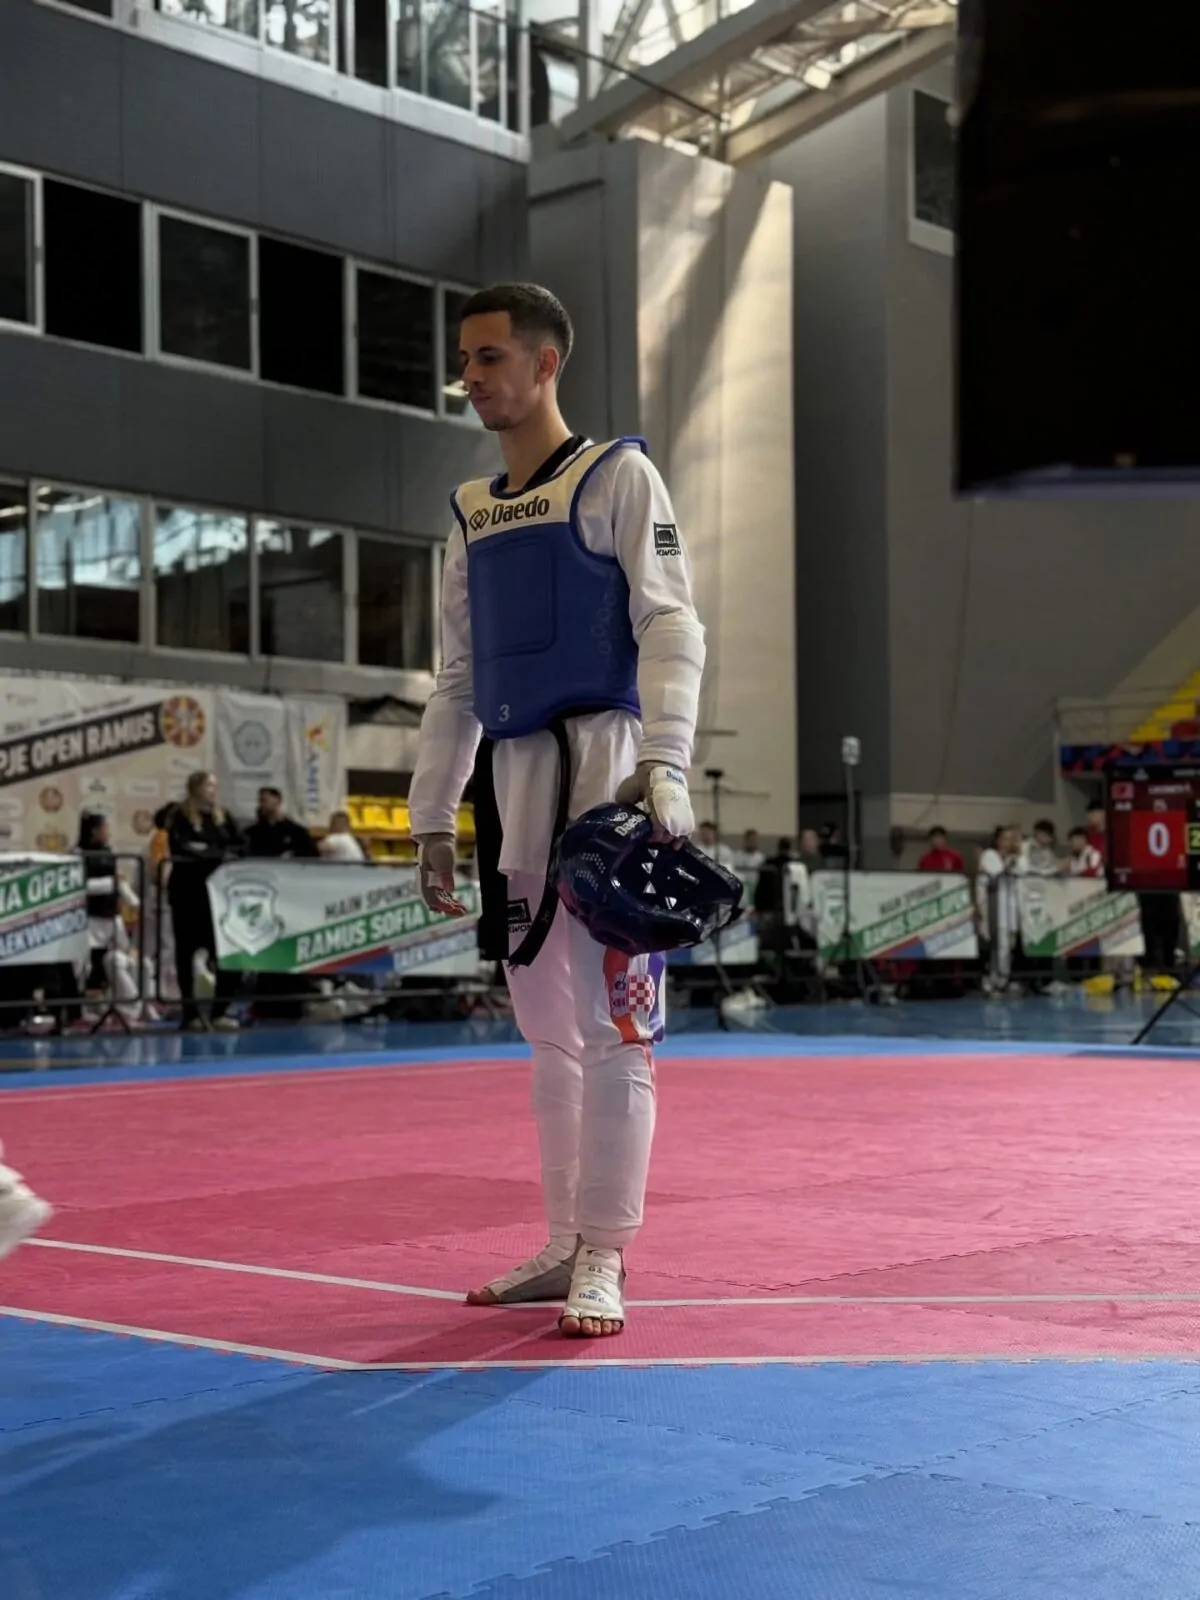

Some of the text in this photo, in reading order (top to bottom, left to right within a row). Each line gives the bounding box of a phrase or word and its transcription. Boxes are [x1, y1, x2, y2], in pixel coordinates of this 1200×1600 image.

[491, 495, 550, 526] Daedo
[656, 548, 682, 557] KWON
[499, 704, 510, 722] 3
[30, 729, 84, 769] OPEN
[86, 711, 155, 754] RAMUS
[1148, 822, 1169, 857] 0
[28, 864, 84, 904] OPEN
[296, 918, 368, 964] RAMUS
[371, 903, 425, 938] SOFIA
